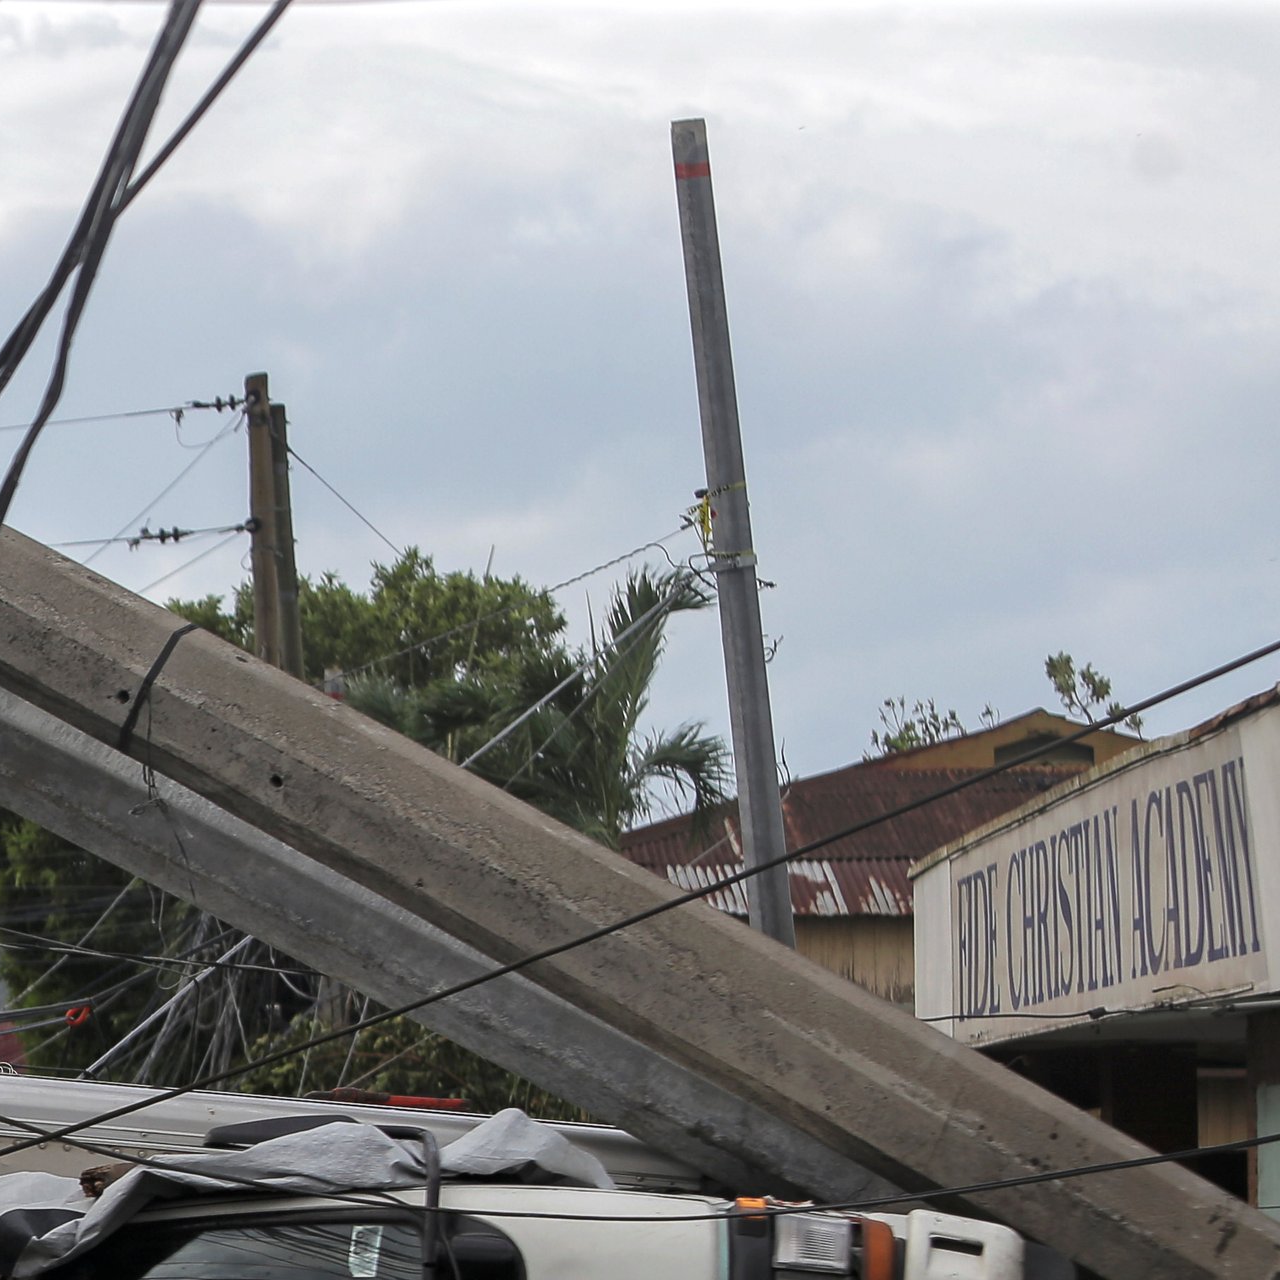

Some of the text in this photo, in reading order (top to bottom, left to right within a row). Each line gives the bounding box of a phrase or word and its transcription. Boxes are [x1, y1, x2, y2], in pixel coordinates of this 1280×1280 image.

[957, 755, 1260, 1022] FIDE CHRISTIAN ACADEMY
